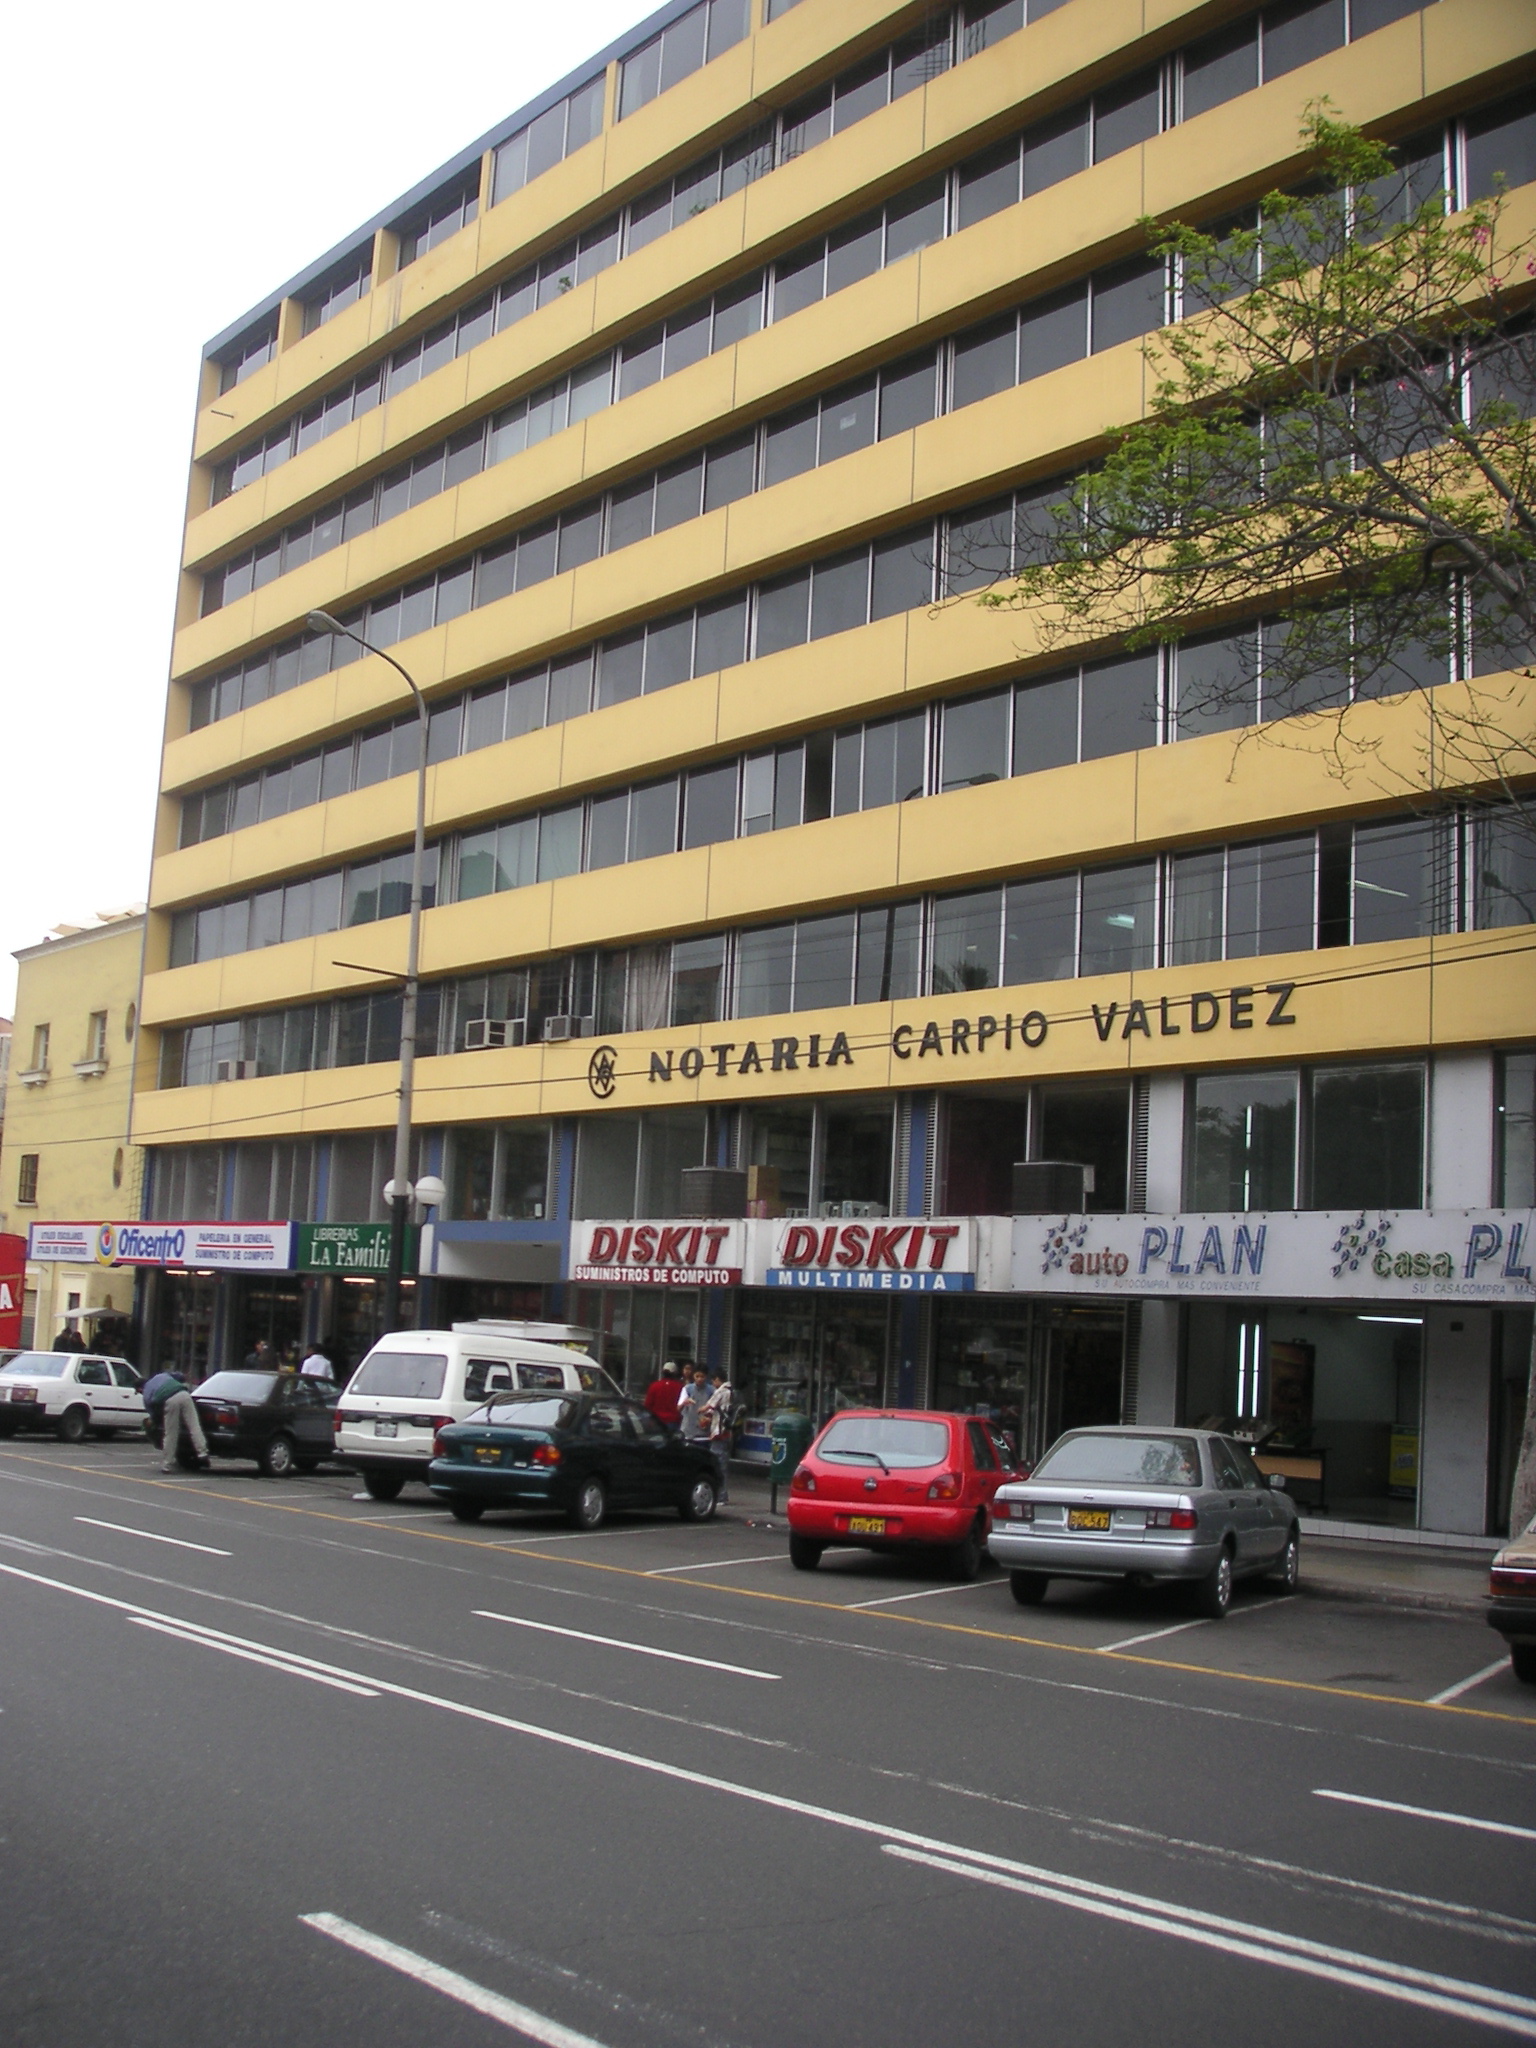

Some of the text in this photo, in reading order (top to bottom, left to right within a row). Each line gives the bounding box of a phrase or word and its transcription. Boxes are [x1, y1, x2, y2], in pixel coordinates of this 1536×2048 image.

[648, 1032, 854, 1081] NOTARIA
[892, 1010, 1048, 1059] CARPIO
[1091, 982, 1296, 1041] VALDEZ
[233, 1233, 241, 1243] EN
[243, 1233, 272, 1243] GENERAL
[313, 1228, 359, 1241] LIBRERIAS
[588, 1225, 730, 1265] DISKIT
[782, 1224, 960, 1269] DISKIT
[1069, 1225, 1267, 1276] auto PLAN
[233, 1250, 241, 1260] DE
[243, 1250, 274, 1260] COMPUTO
[1372, 1250, 1454, 1278] casa
[576, 1265, 730, 1284] SUMINISTROS DE COMPUTO
[778, 1271, 947, 1290] MULTIMEDIA
[1095, 1279, 1260, 1291] SU AUTOCOMPRA MAS CONVENIENTE
[1412, 1283, 1427, 1293] SU
[1433, 1283, 1506, 1295] CASACOMPRA
